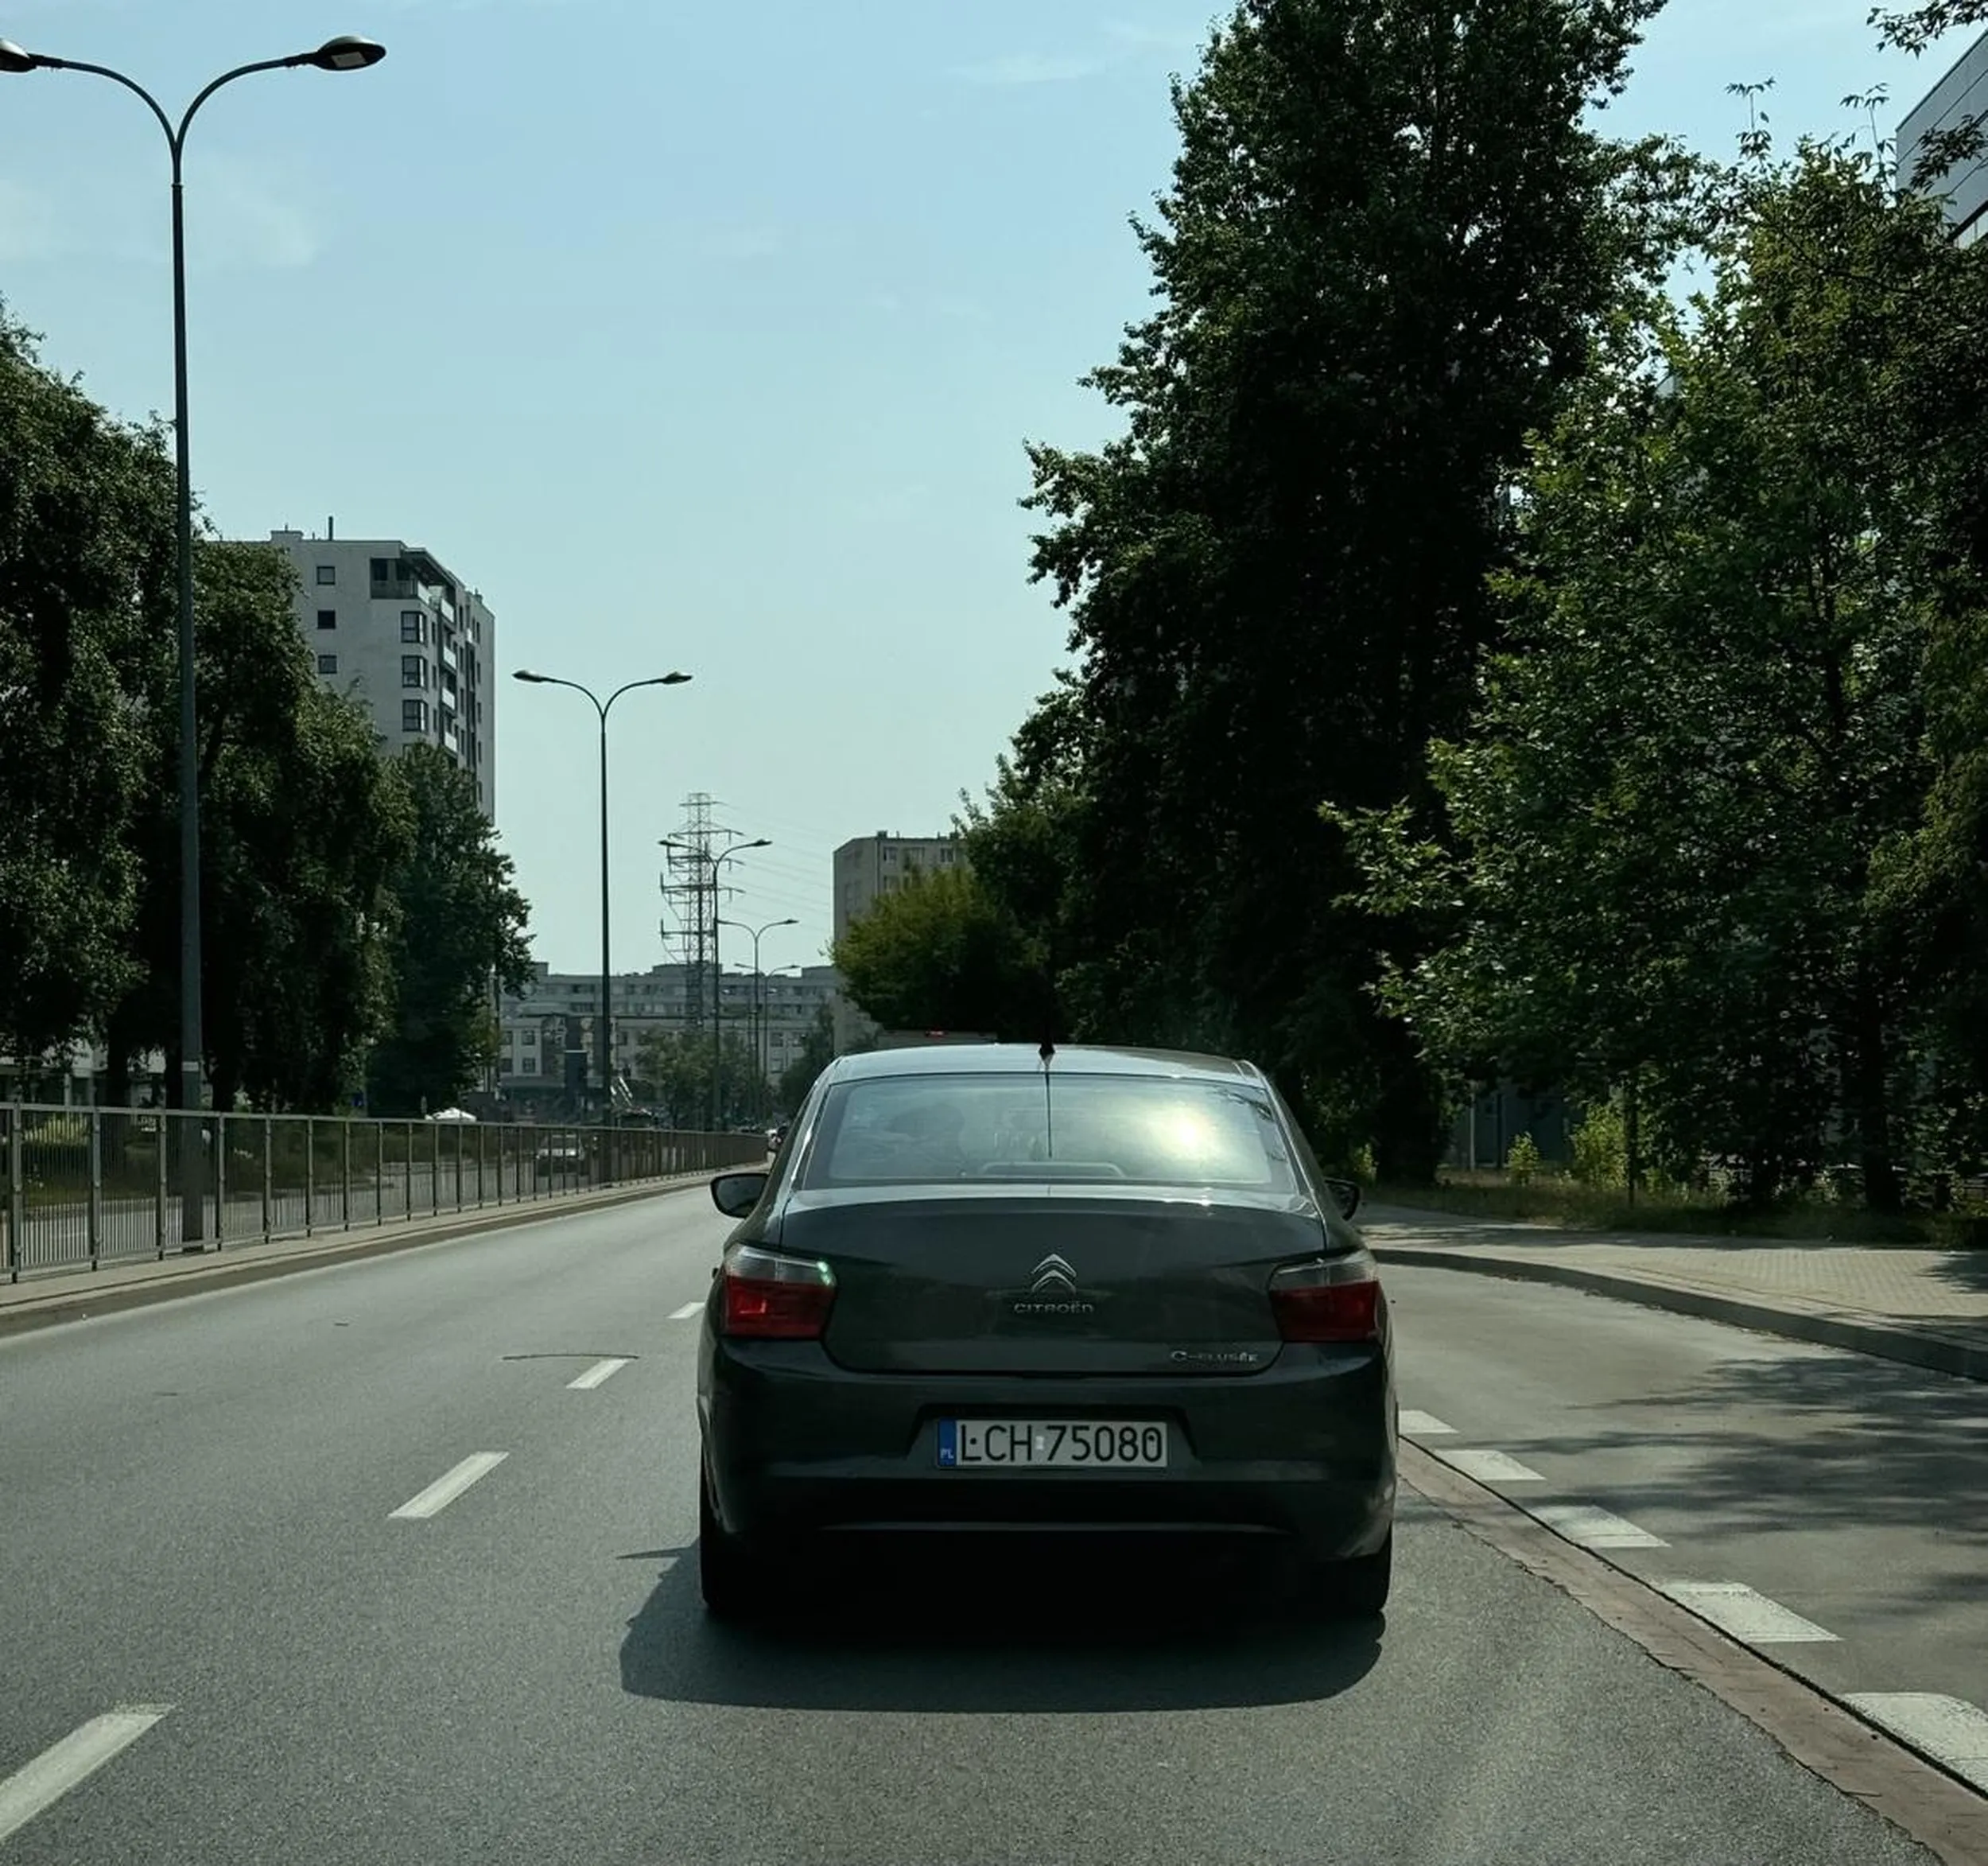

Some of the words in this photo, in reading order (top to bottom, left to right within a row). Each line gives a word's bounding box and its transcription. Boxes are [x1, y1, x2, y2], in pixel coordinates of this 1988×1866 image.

[940, 1448, 954, 1460] PL
[961, 1424, 1032, 1461] LCH
[1046, 1425, 1162, 1462] 75080
